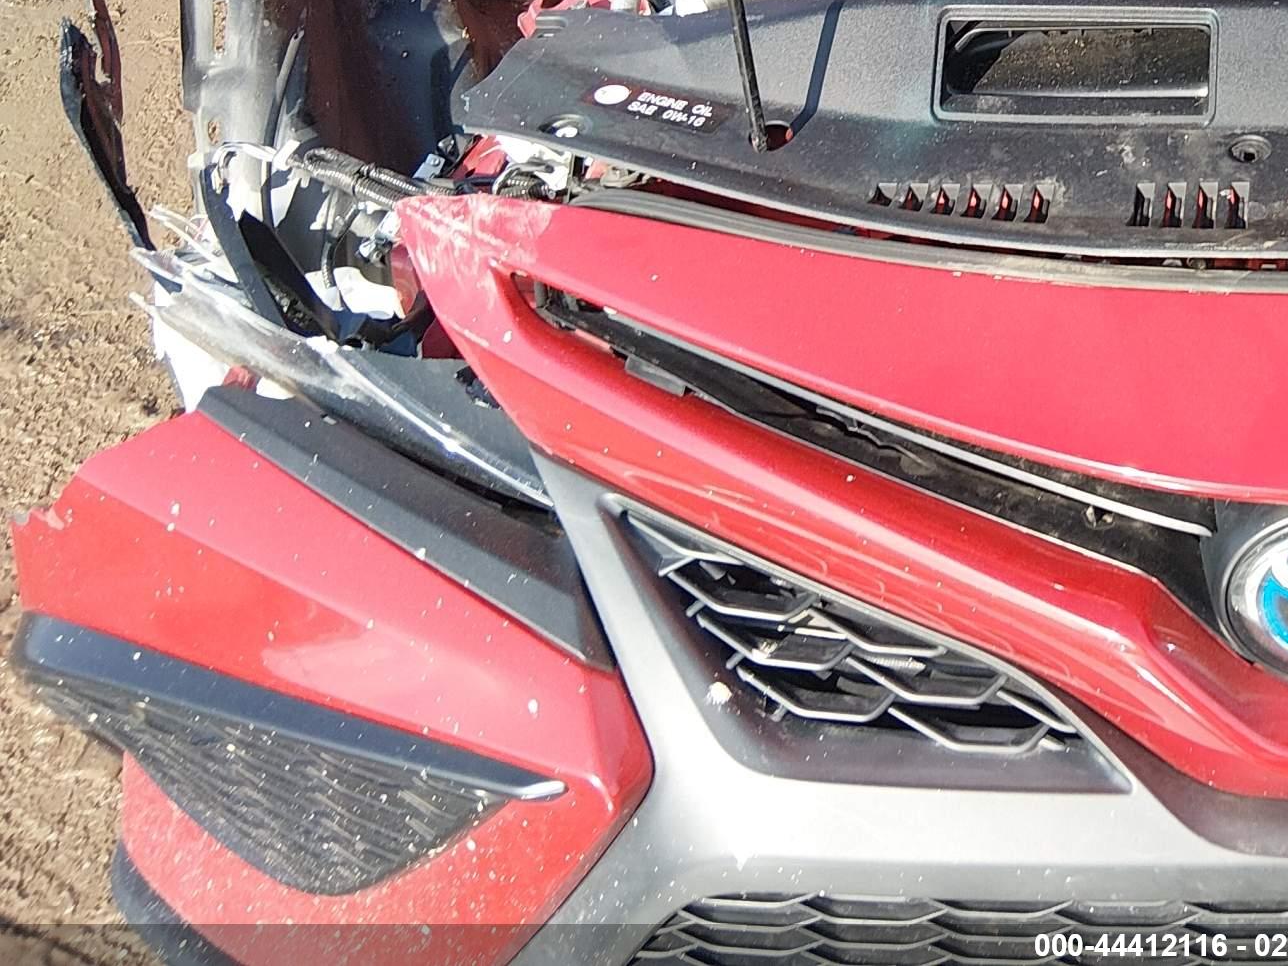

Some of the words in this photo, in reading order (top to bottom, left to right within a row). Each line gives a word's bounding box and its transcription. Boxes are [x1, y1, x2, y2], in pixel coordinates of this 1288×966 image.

[627, 101, 658, 116] SAE
[637, 92, 688, 111] ENGINE
[691, 104, 713, 117] OIL
